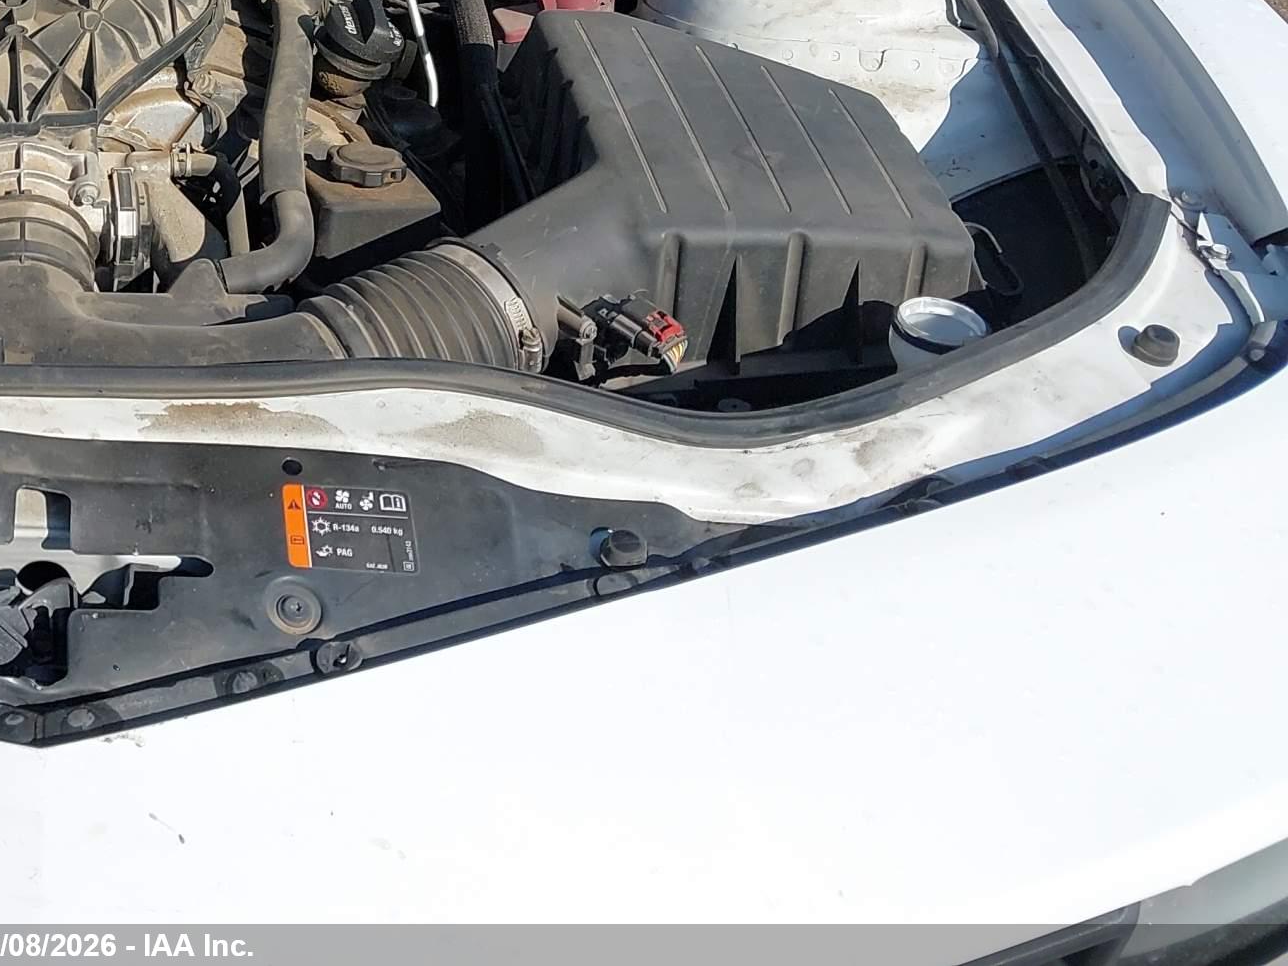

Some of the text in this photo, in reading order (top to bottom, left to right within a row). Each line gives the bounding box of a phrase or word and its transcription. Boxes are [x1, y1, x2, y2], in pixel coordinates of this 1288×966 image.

[335, 502, 352, 510] AUTO
[332, 523, 403, 536] R-134a 0.540 kg
[336, 547, 353, 557] PAG
